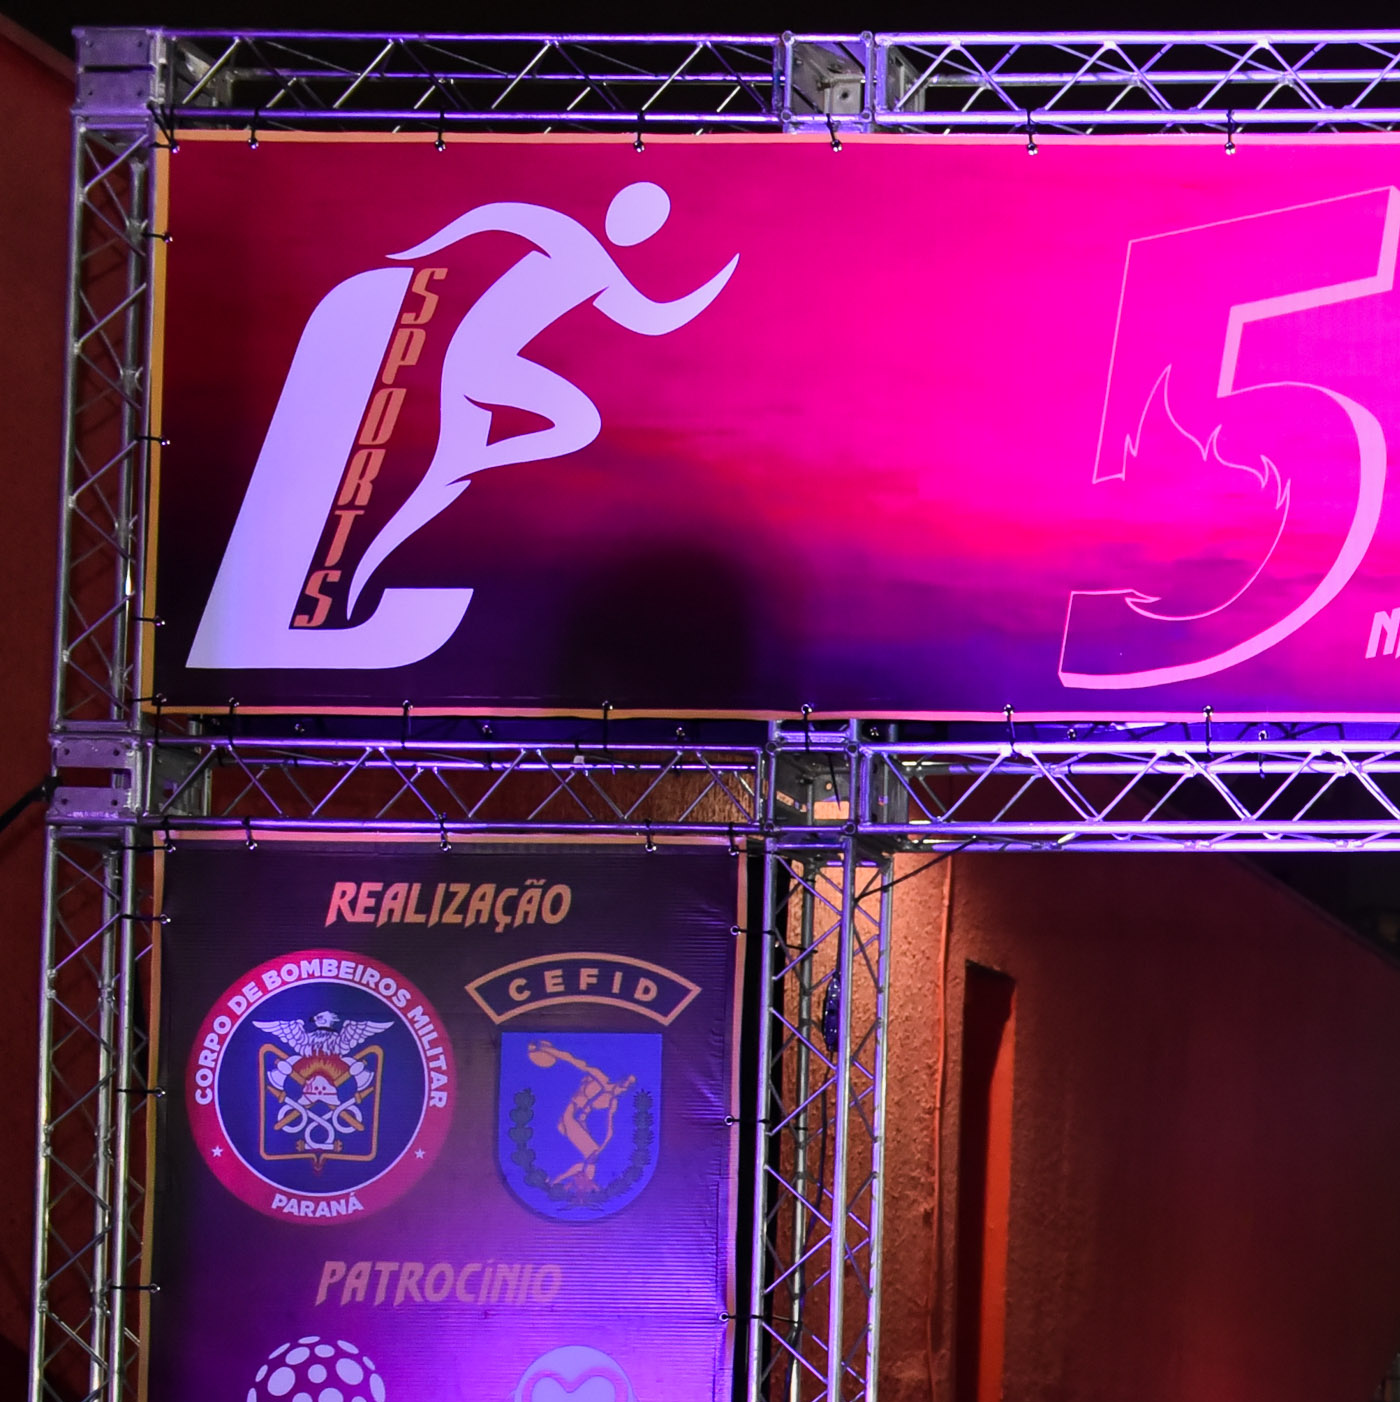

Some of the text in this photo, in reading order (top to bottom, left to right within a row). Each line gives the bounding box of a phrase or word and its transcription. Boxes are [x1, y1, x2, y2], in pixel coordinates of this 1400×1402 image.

[293, 267, 448, 628] SPORTS
[324, 878, 573, 934] REALIZAÇÃO
[508, 967, 660, 1003] CEFID
[194, 958, 449, 1109] CORPO DE BOMBEIROS MILITAR
[270, 1191, 365, 1218] PARANÁ
[315, 1259, 563, 1308] PATROCÍNIO
